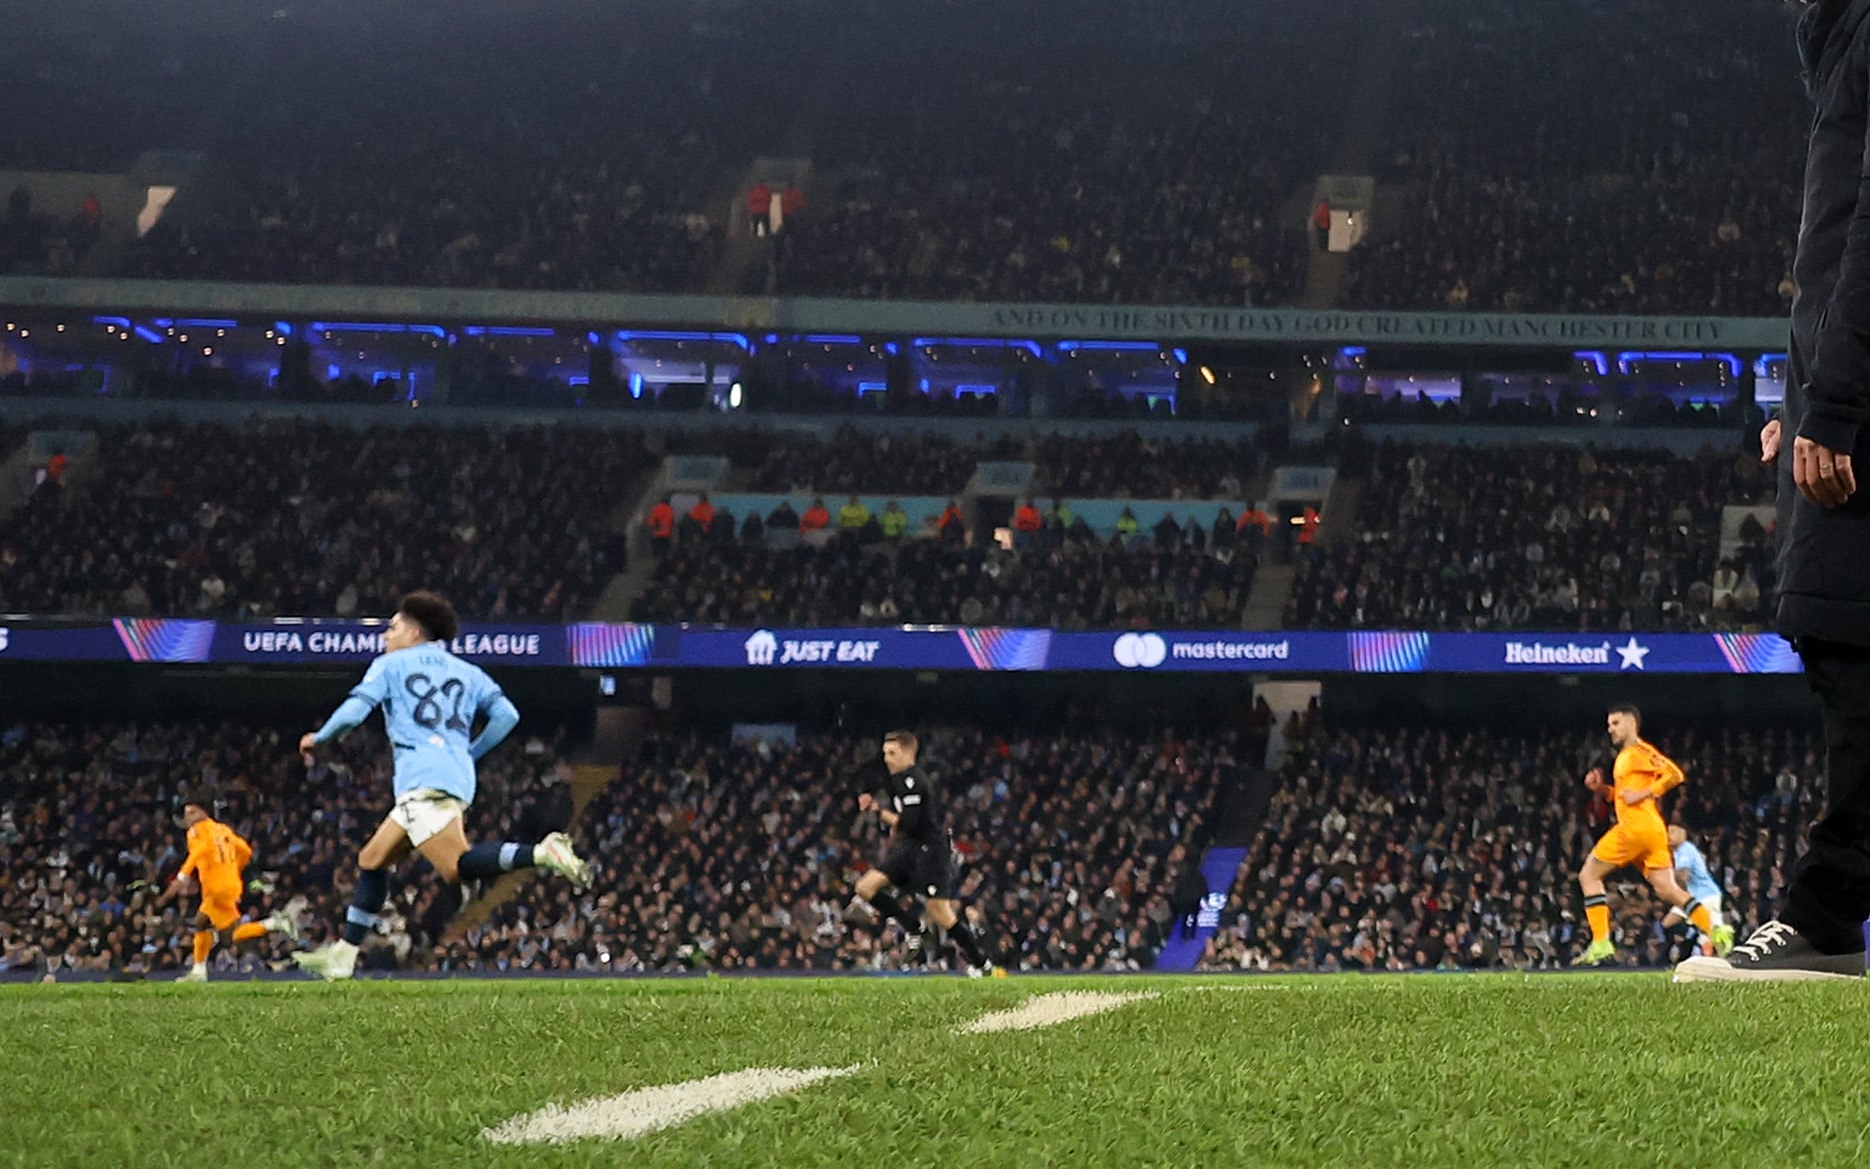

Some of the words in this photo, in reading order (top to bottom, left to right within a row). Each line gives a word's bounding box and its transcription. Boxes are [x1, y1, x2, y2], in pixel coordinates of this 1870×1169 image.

[994, 310, 1043, 326] AND
[1051, 311, 1086, 328] ON
[1097, 311, 1148, 329] THE
[1154, 312, 1230, 332] SIXTH
[1239, 314, 1283, 332] DAY
[1294, 316, 1350, 333] GOD
[1357, 317, 1477, 335] CREATED
[1482, 319, 1656, 339] MANCHESTER
[1664, 321, 1722, 340] CITY
[244, 632, 302, 652] UEFA
[452, 634, 540, 654] LEAGUE
[780, 640, 835, 664] JUST
[836, 640, 880, 662] EAT
[1172, 640, 1289, 659] mastercard
[1505, 642, 1609, 664] Heineken
[405, 673, 468, 730] 82
